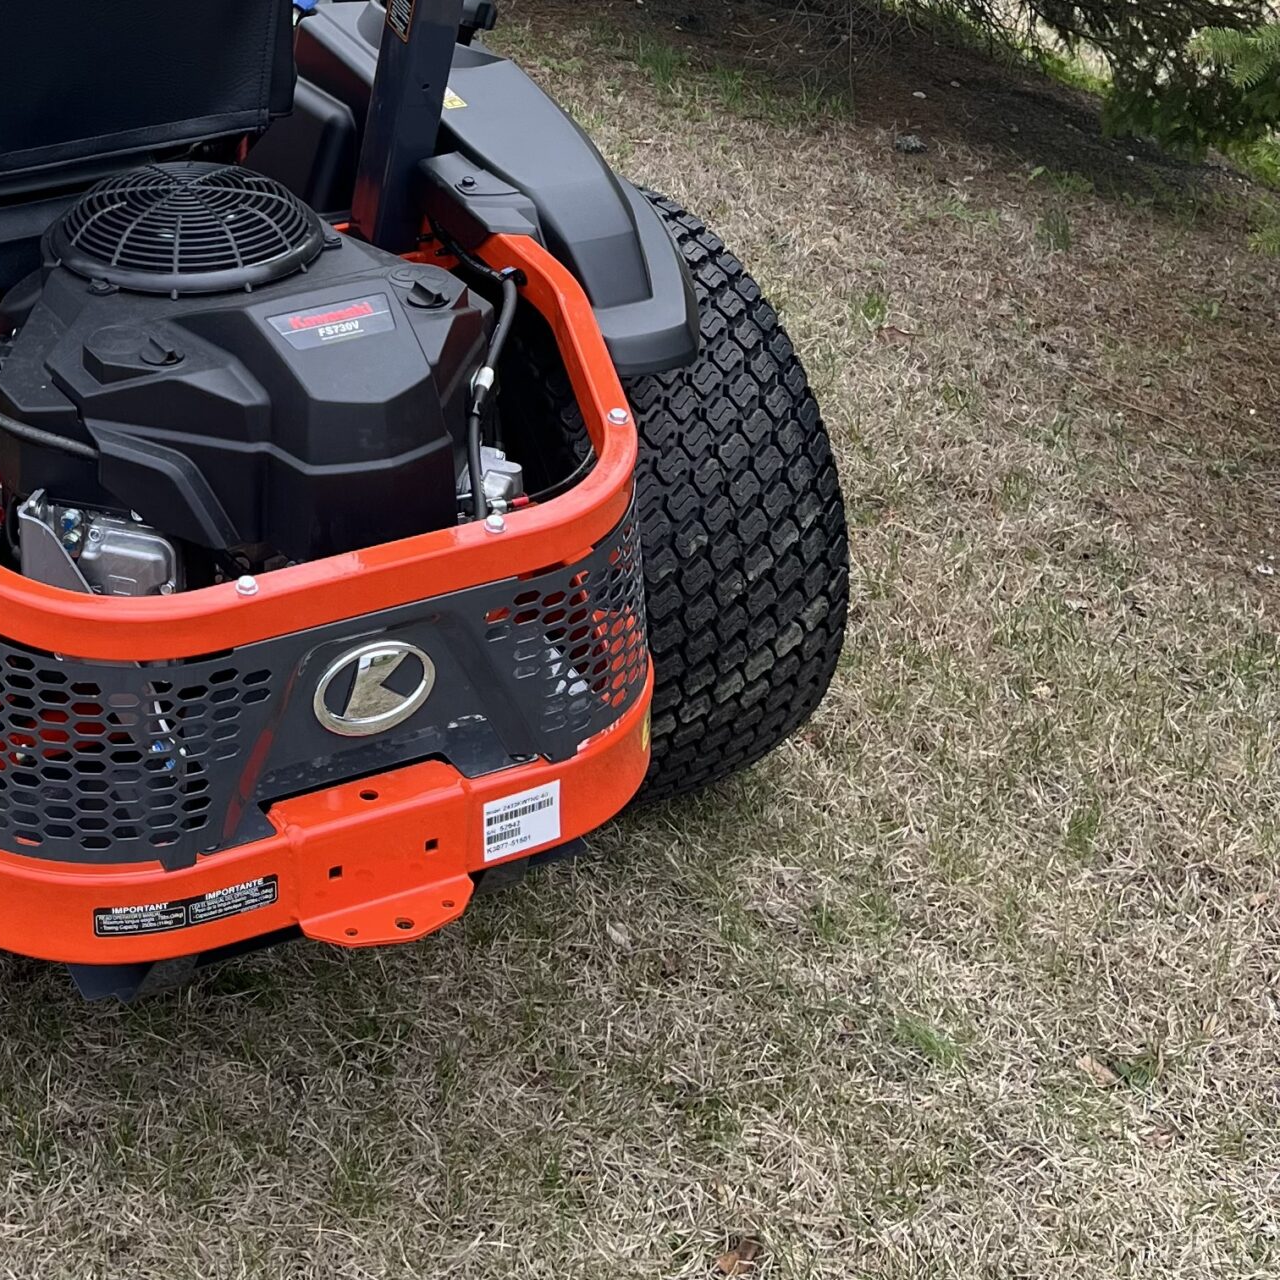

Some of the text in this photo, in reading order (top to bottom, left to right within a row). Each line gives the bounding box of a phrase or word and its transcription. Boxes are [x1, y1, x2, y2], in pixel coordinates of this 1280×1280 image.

[318, 320, 360, 337] FS730V
[205, 877, 264, 900] IMPORTANTE
[111, 902, 169, 915] IMPORTANT
